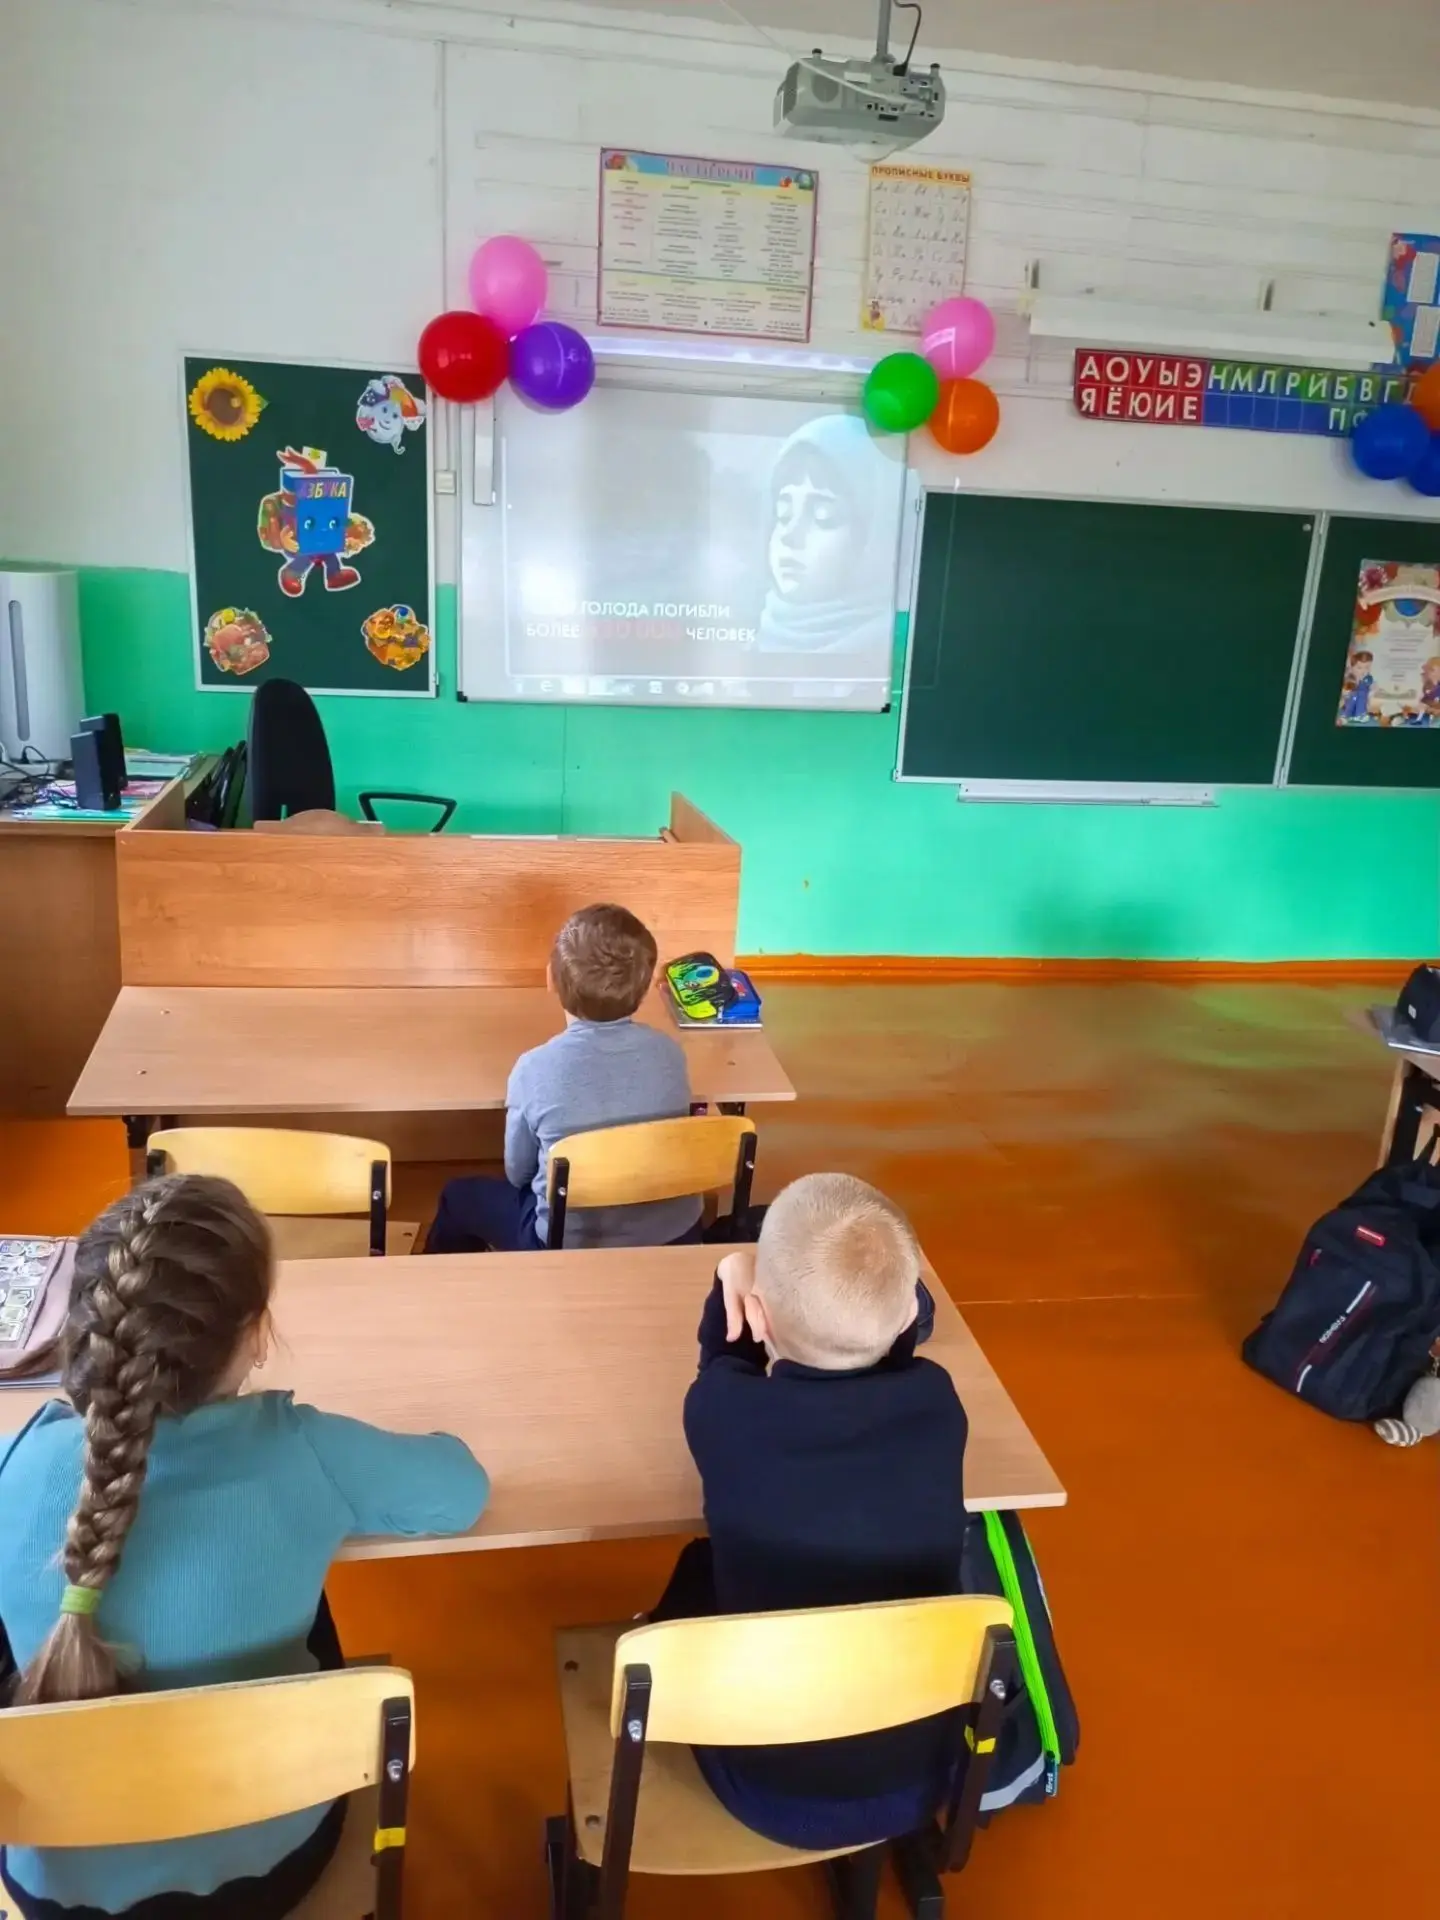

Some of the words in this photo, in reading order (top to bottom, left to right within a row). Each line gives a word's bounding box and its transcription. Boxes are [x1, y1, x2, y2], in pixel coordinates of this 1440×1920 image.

[871, 166, 933, 180] ПРОПИСНЫЕ
[936, 171, 970, 183] БУКВЫ
[581, 600, 649, 618] ГОЛОДА
[653, 602, 731, 618] ПОГИБЛИ
[526, 622, 581, 639] БОЛЕЕ
[686, 627, 756, 643] ЧЕЛОВЕК
